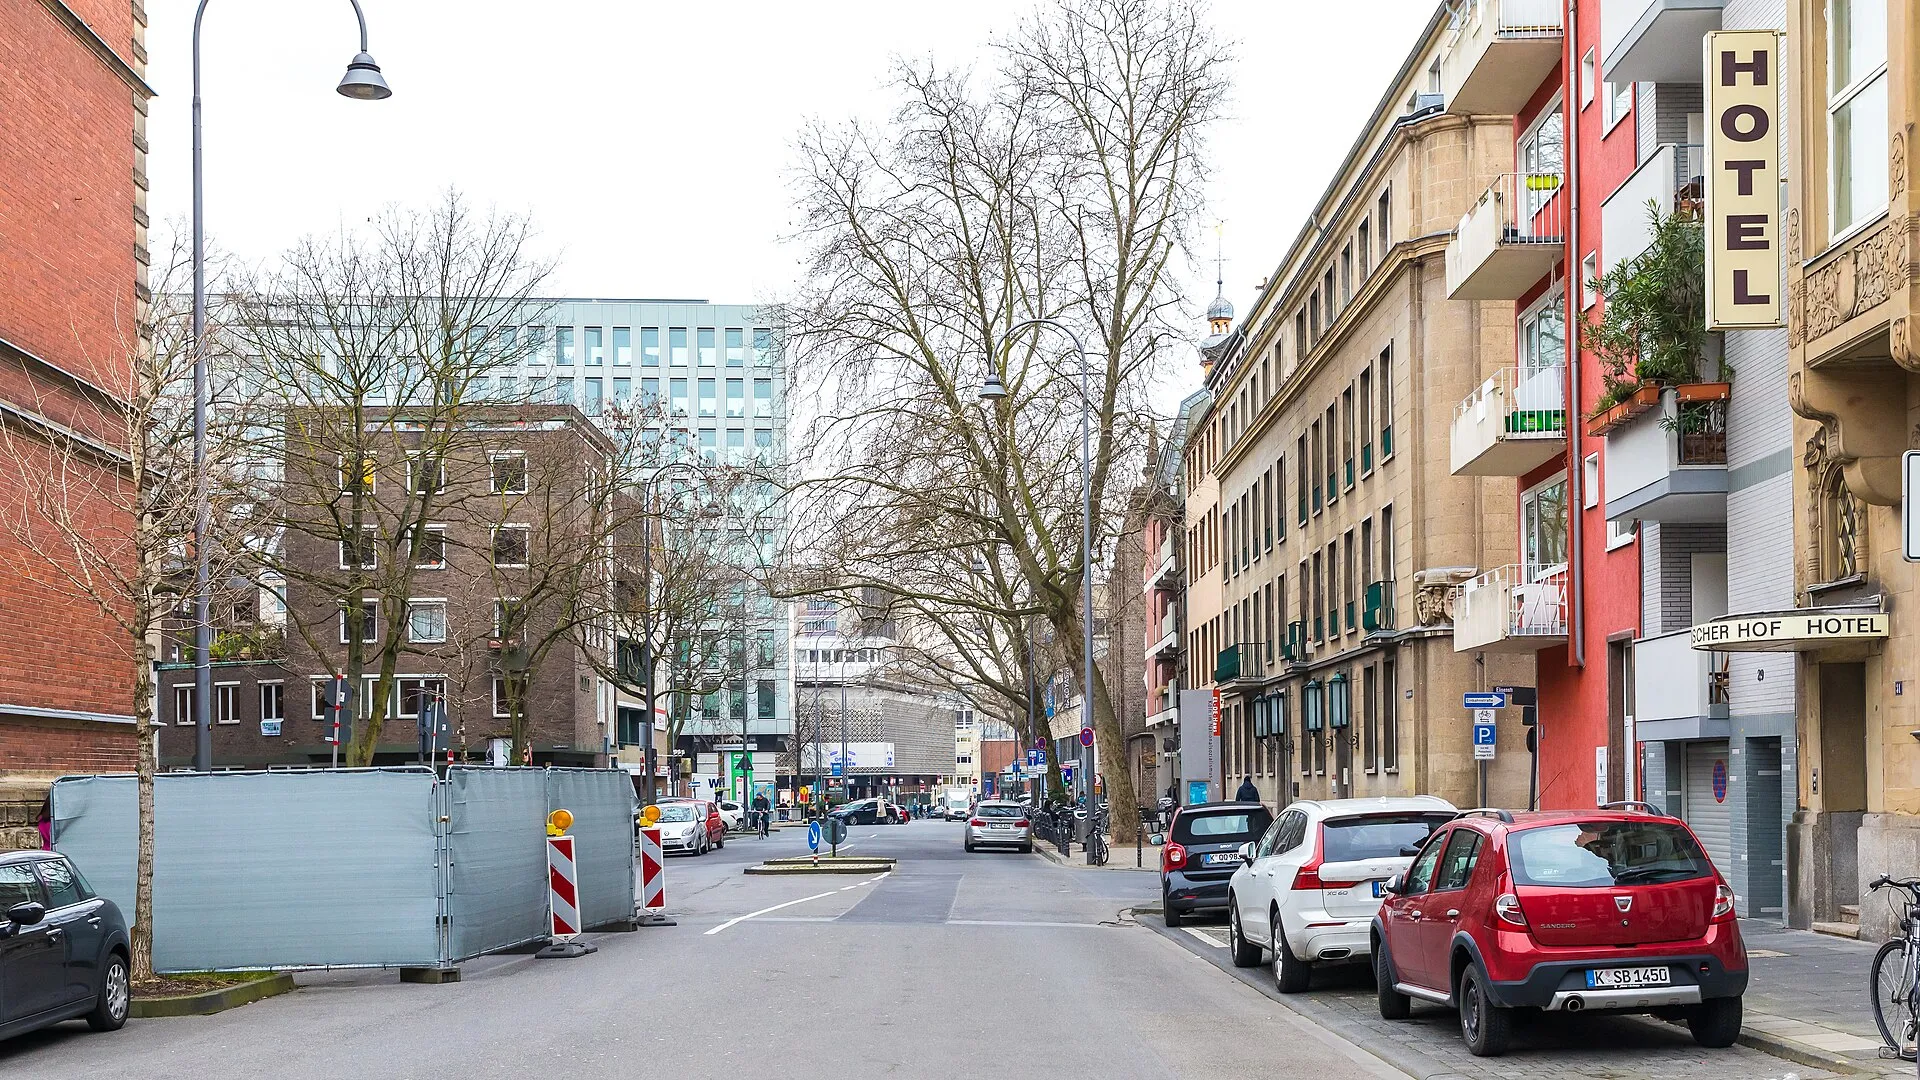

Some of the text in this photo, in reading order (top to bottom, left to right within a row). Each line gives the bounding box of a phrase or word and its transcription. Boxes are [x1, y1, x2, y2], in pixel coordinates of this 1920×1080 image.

[1721, 50, 1770, 305] HOTEL
[1692, 617, 1882, 643] SCHER HOF HOTEL
[1479, 728, 1490, 743] P
[1210, 854, 1215, 862] K
[1379, 882, 1387, 893] K
[1595, 971, 1605, 984] K
[1613, 970, 1631, 983] SB
[1633, 968, 1668, 983] 1450
